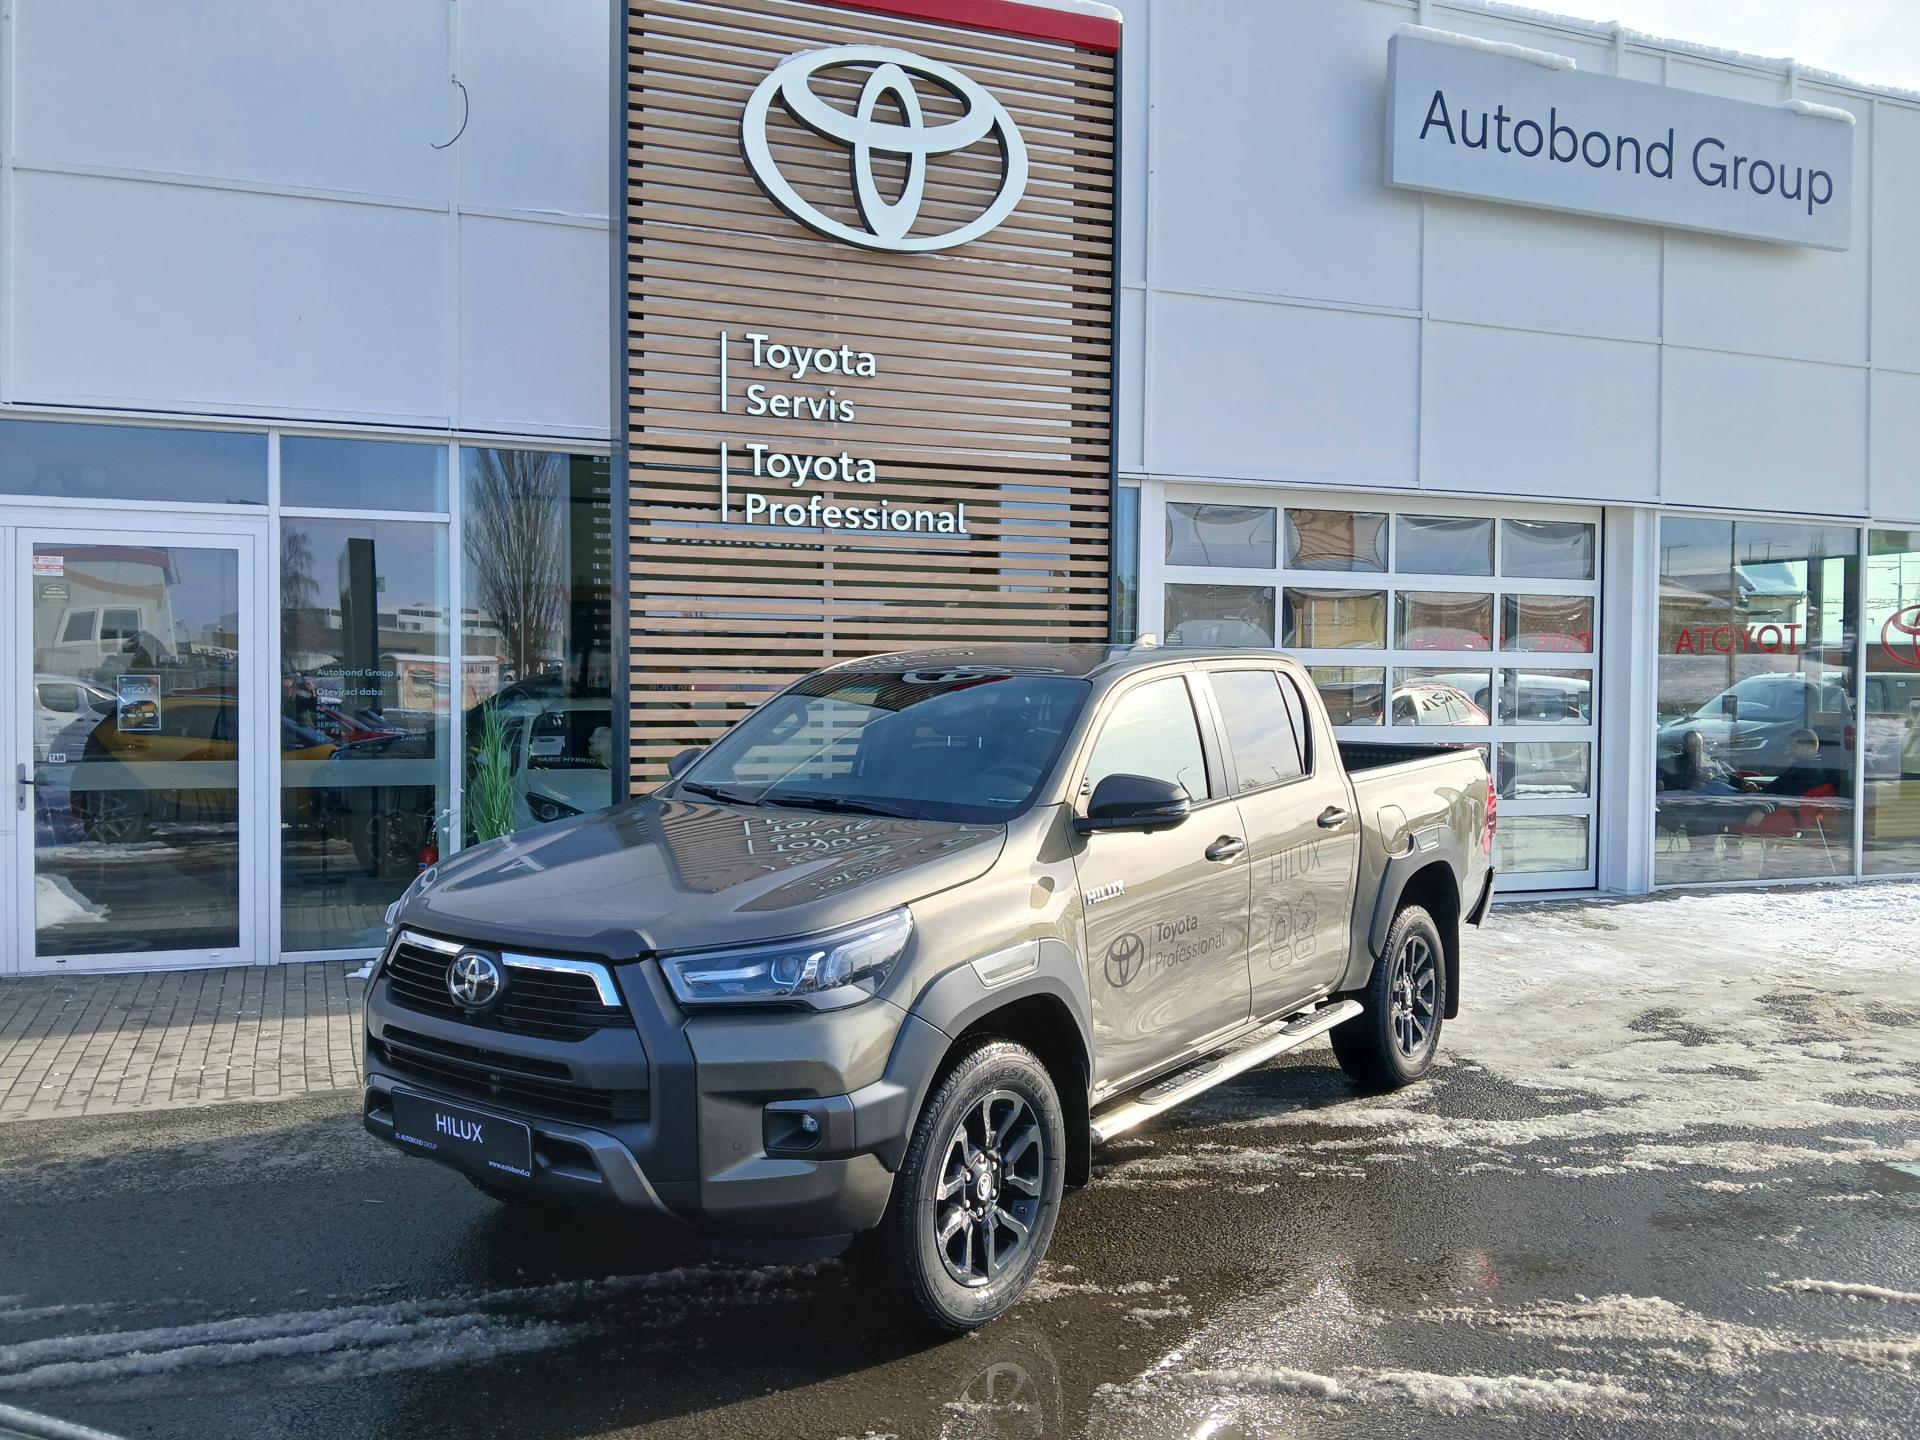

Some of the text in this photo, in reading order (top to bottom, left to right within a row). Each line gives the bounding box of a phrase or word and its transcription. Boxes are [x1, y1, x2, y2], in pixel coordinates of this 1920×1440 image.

[1419, 89, 1835, 216] Autobond Group
[745, 333, 877, 380] Toyota
[746, 384, 856, 423] Servis
[745, 443, 877, 488] Toyota
[746, 491, 969, 535] Professional
[317, 668, 363, 677] Autobond
[365, 669, 394, 678] Group
[1271, 839, 1321, 885] HILUX
[1154, 927, 1226, 972] Professional
[1156, 914, 1198, 943] Toyota
[435, 1112, 484, 1144] HILUX
